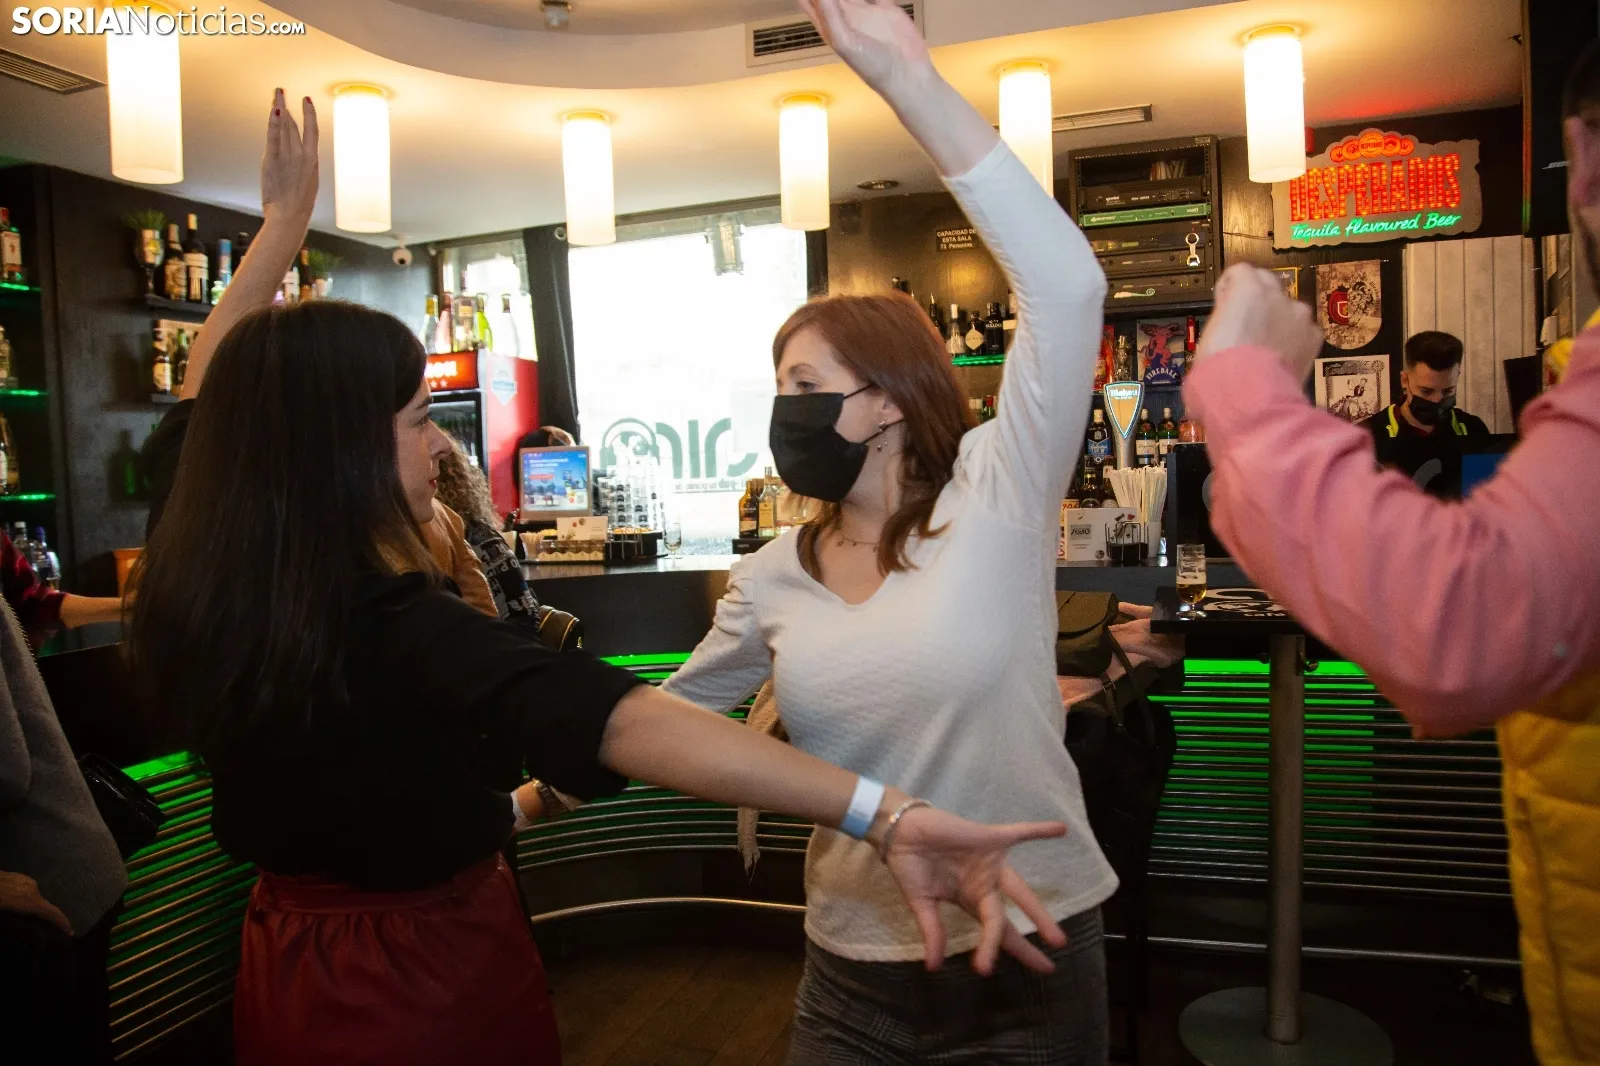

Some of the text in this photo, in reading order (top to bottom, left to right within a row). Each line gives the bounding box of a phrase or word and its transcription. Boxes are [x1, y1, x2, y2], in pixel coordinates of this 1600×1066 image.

[1290, 153, 1461, 222] DESPERADOS
[936, 229, 968, 237] CAPACIDAD
[1290, 222, 1341, 243] Tequila
[1423, 212, 1462, 230] Beer
